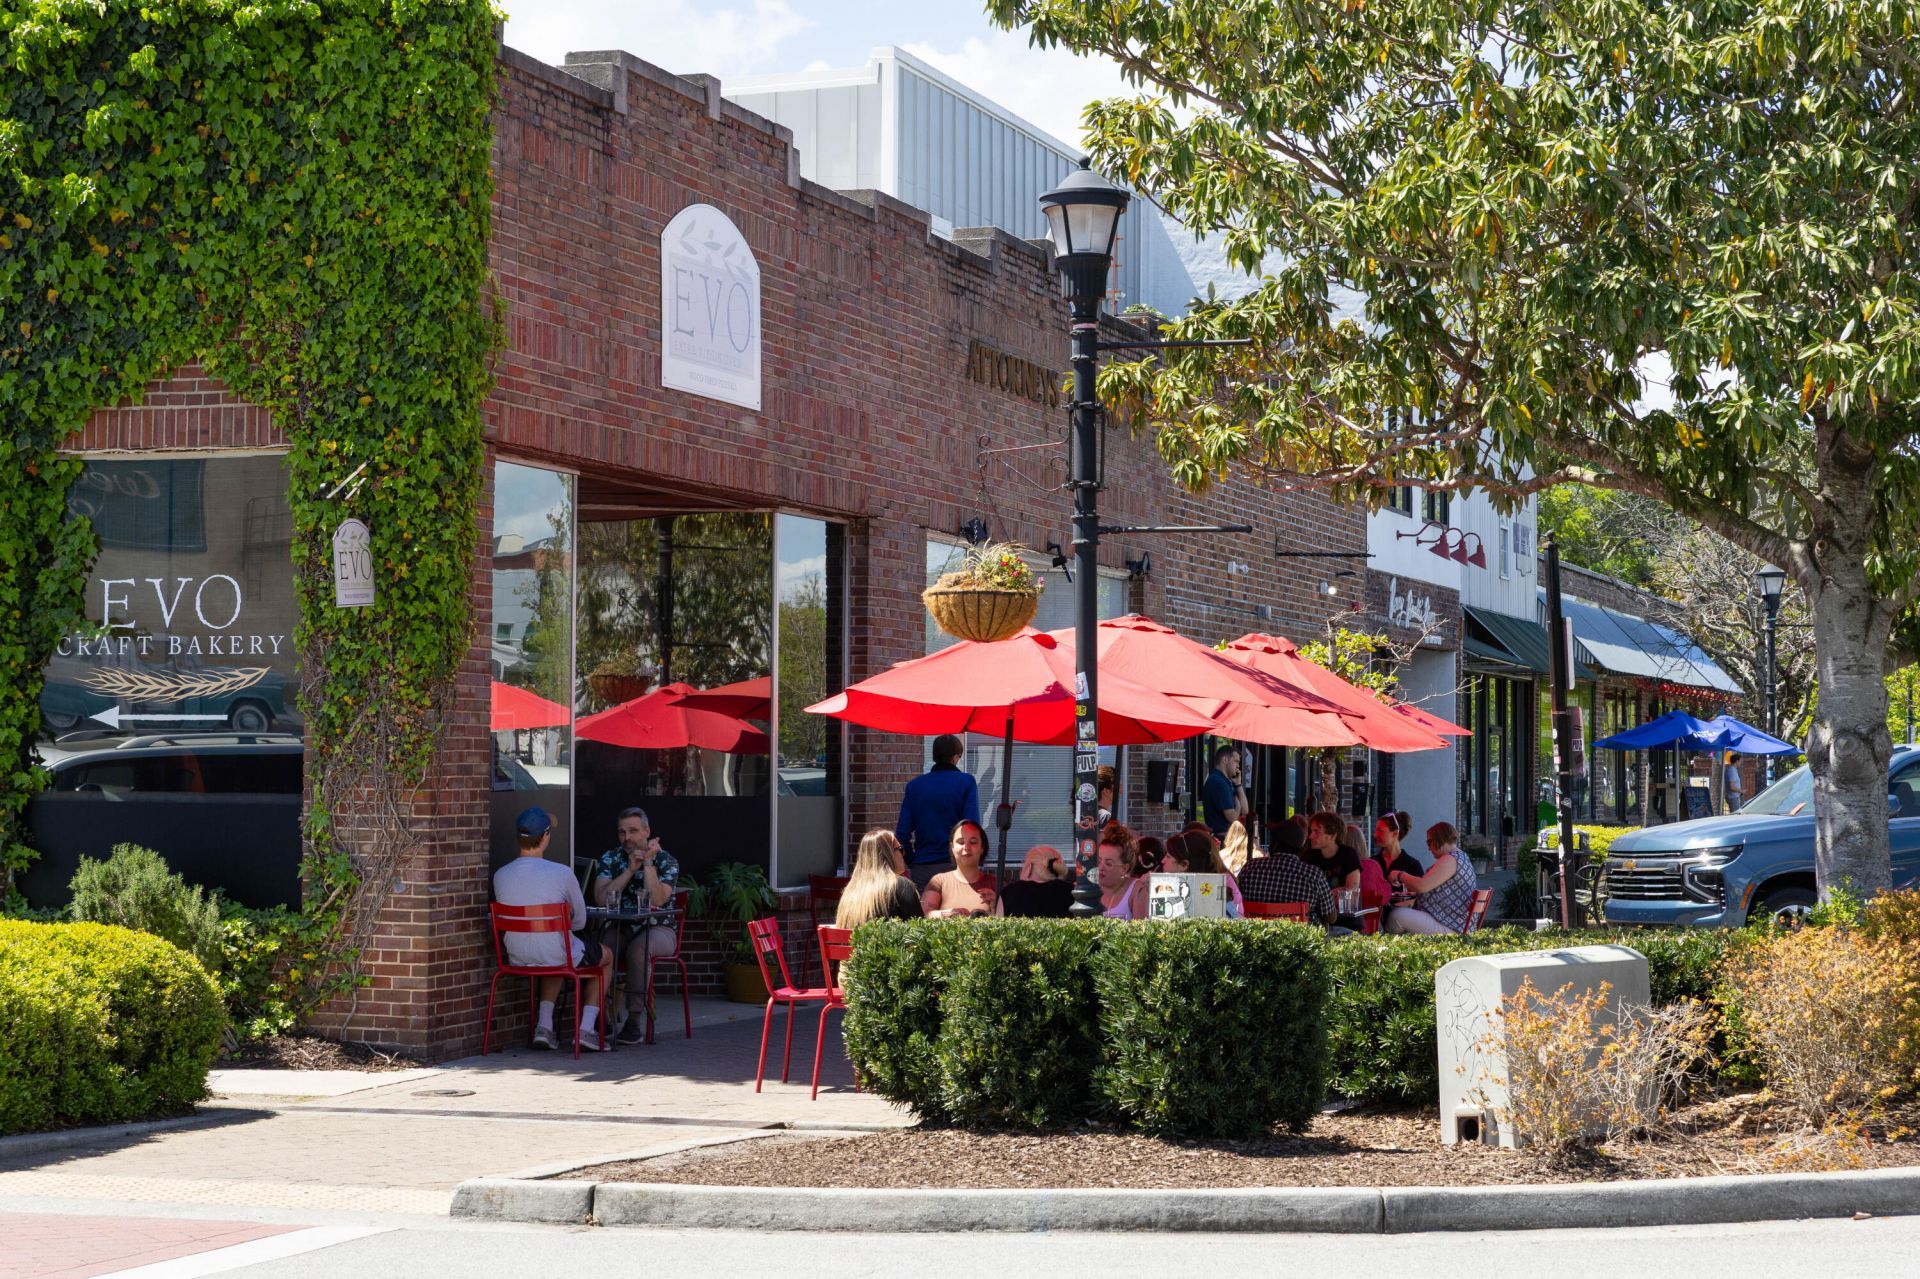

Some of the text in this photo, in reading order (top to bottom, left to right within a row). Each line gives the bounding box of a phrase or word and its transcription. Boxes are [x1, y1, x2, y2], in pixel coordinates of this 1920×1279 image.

[672, 263, 751, 353] EVO
[966, 339, 1059, 409] ATTORNEYS
[339, 549, 372, 580] EVO
[100, 574, 242, 630] EVO
[56, 635, 285, 656] CRAFT BAKERY
[1077, 755, 1097, 772] PULP
